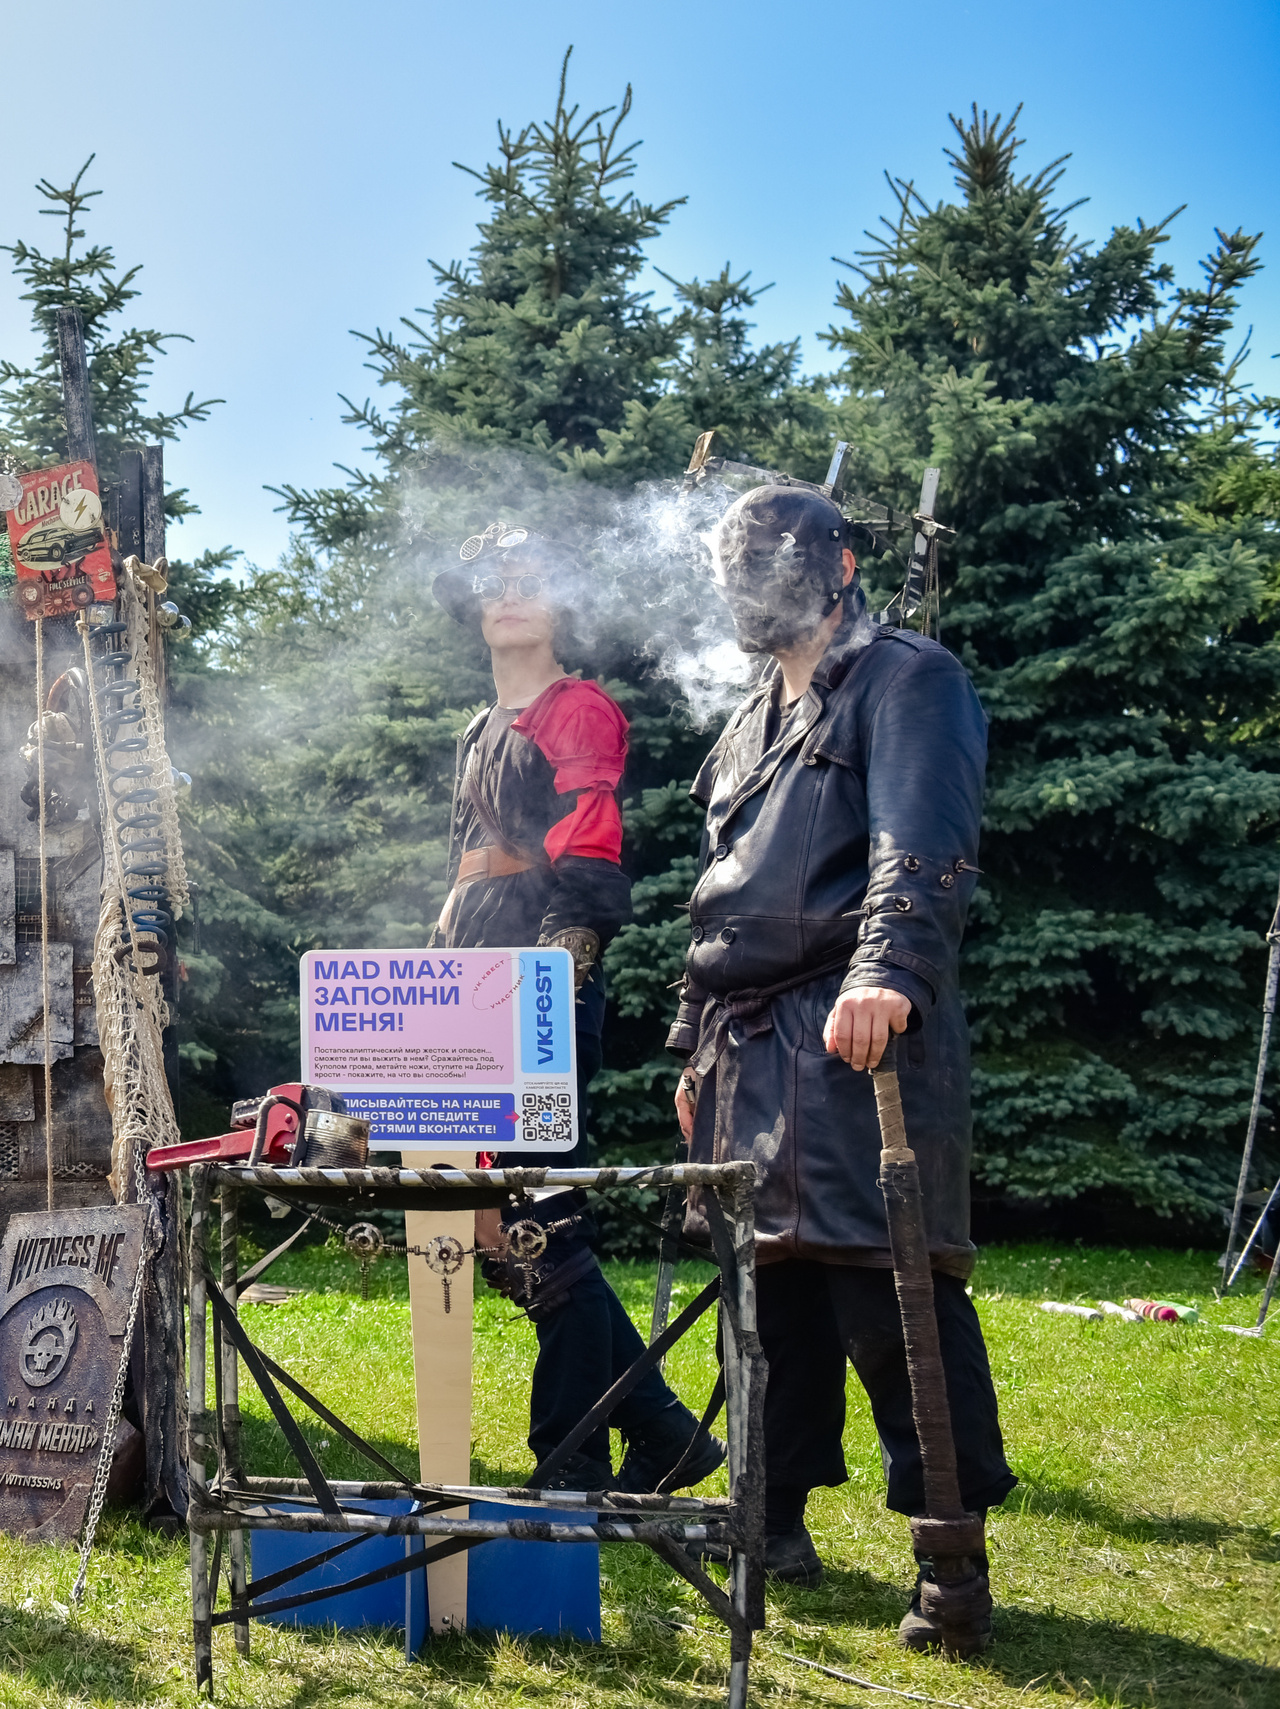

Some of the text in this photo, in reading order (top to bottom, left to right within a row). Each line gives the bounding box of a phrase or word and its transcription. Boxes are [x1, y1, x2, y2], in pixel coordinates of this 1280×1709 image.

[14, 469, 83, 525] GARAGE
[63, 576, 85, 589] SERVICE
[314, 959, 463, 980] MAD MAX:
[482, 959, 505, 980] КВЕСТ
[314, 986, 460, 1006] ЗАПОМНИ
[490, 974, 525, 1009] УЧАСТНИК
[315, 1012, 405, 1032] МЕНЯ!
[314, 1046, 403, 1054] Постапокалиптический
[431, 1055, 479, 1063] Сражайтесь
[314, 1063, 347, 1071] Куполом
[475, 1063, 505, 1071] Дорогу
[343, 1097, 501, 1109] ПИСЫВАЙТЕСЬ НА НАШЕ
[407, 1112, 417, 1121] И
[420, 1112, 479, 1122] СЛЕДИТЕ
[370, 1124, 497, 1134] СТЯМИ ВКОНТАКТЕ!
[7, 1232, 126, 1294] WITNESS ME
[38, 1423, 99, 1454] МЕНЯ!»
